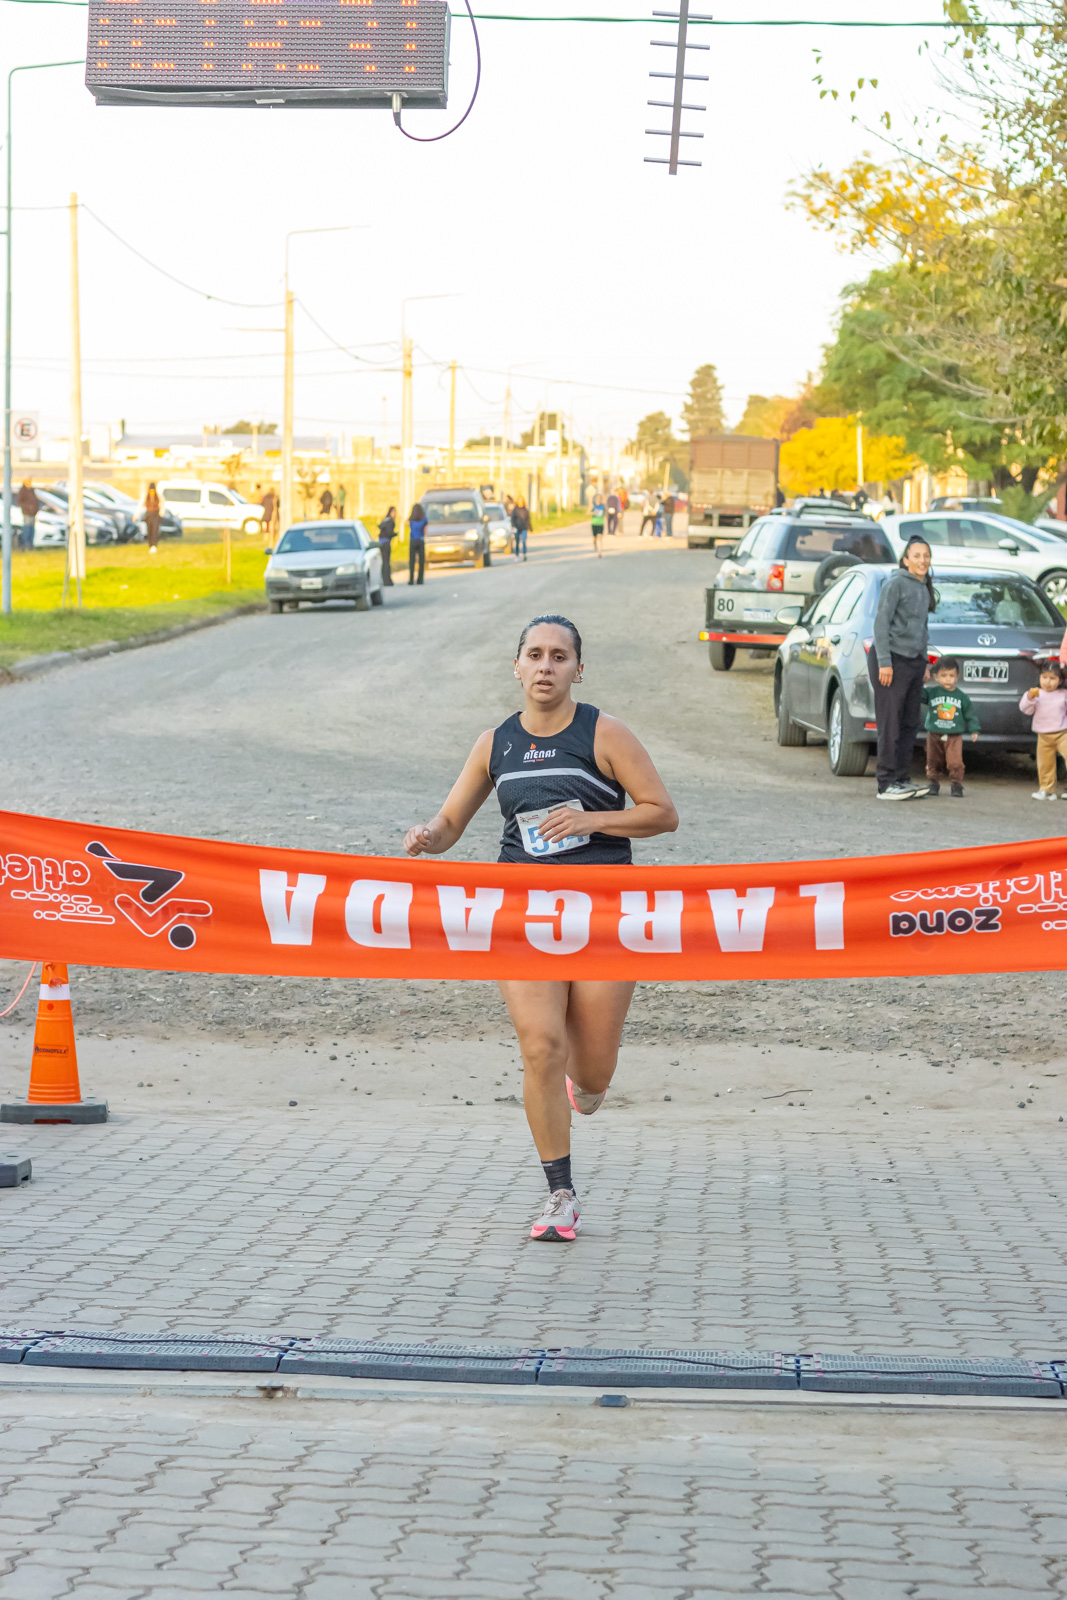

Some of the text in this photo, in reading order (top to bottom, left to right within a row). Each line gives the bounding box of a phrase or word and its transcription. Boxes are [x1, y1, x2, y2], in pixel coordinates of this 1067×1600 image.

[717, 598, 735, 612] 80
[965, 665, 1007, 678] PKT 477
[523, 749, 557, 760] ATENAS
[258, 868, 846, 955] LARGADA
[889, 906, 1002, 937] zona
